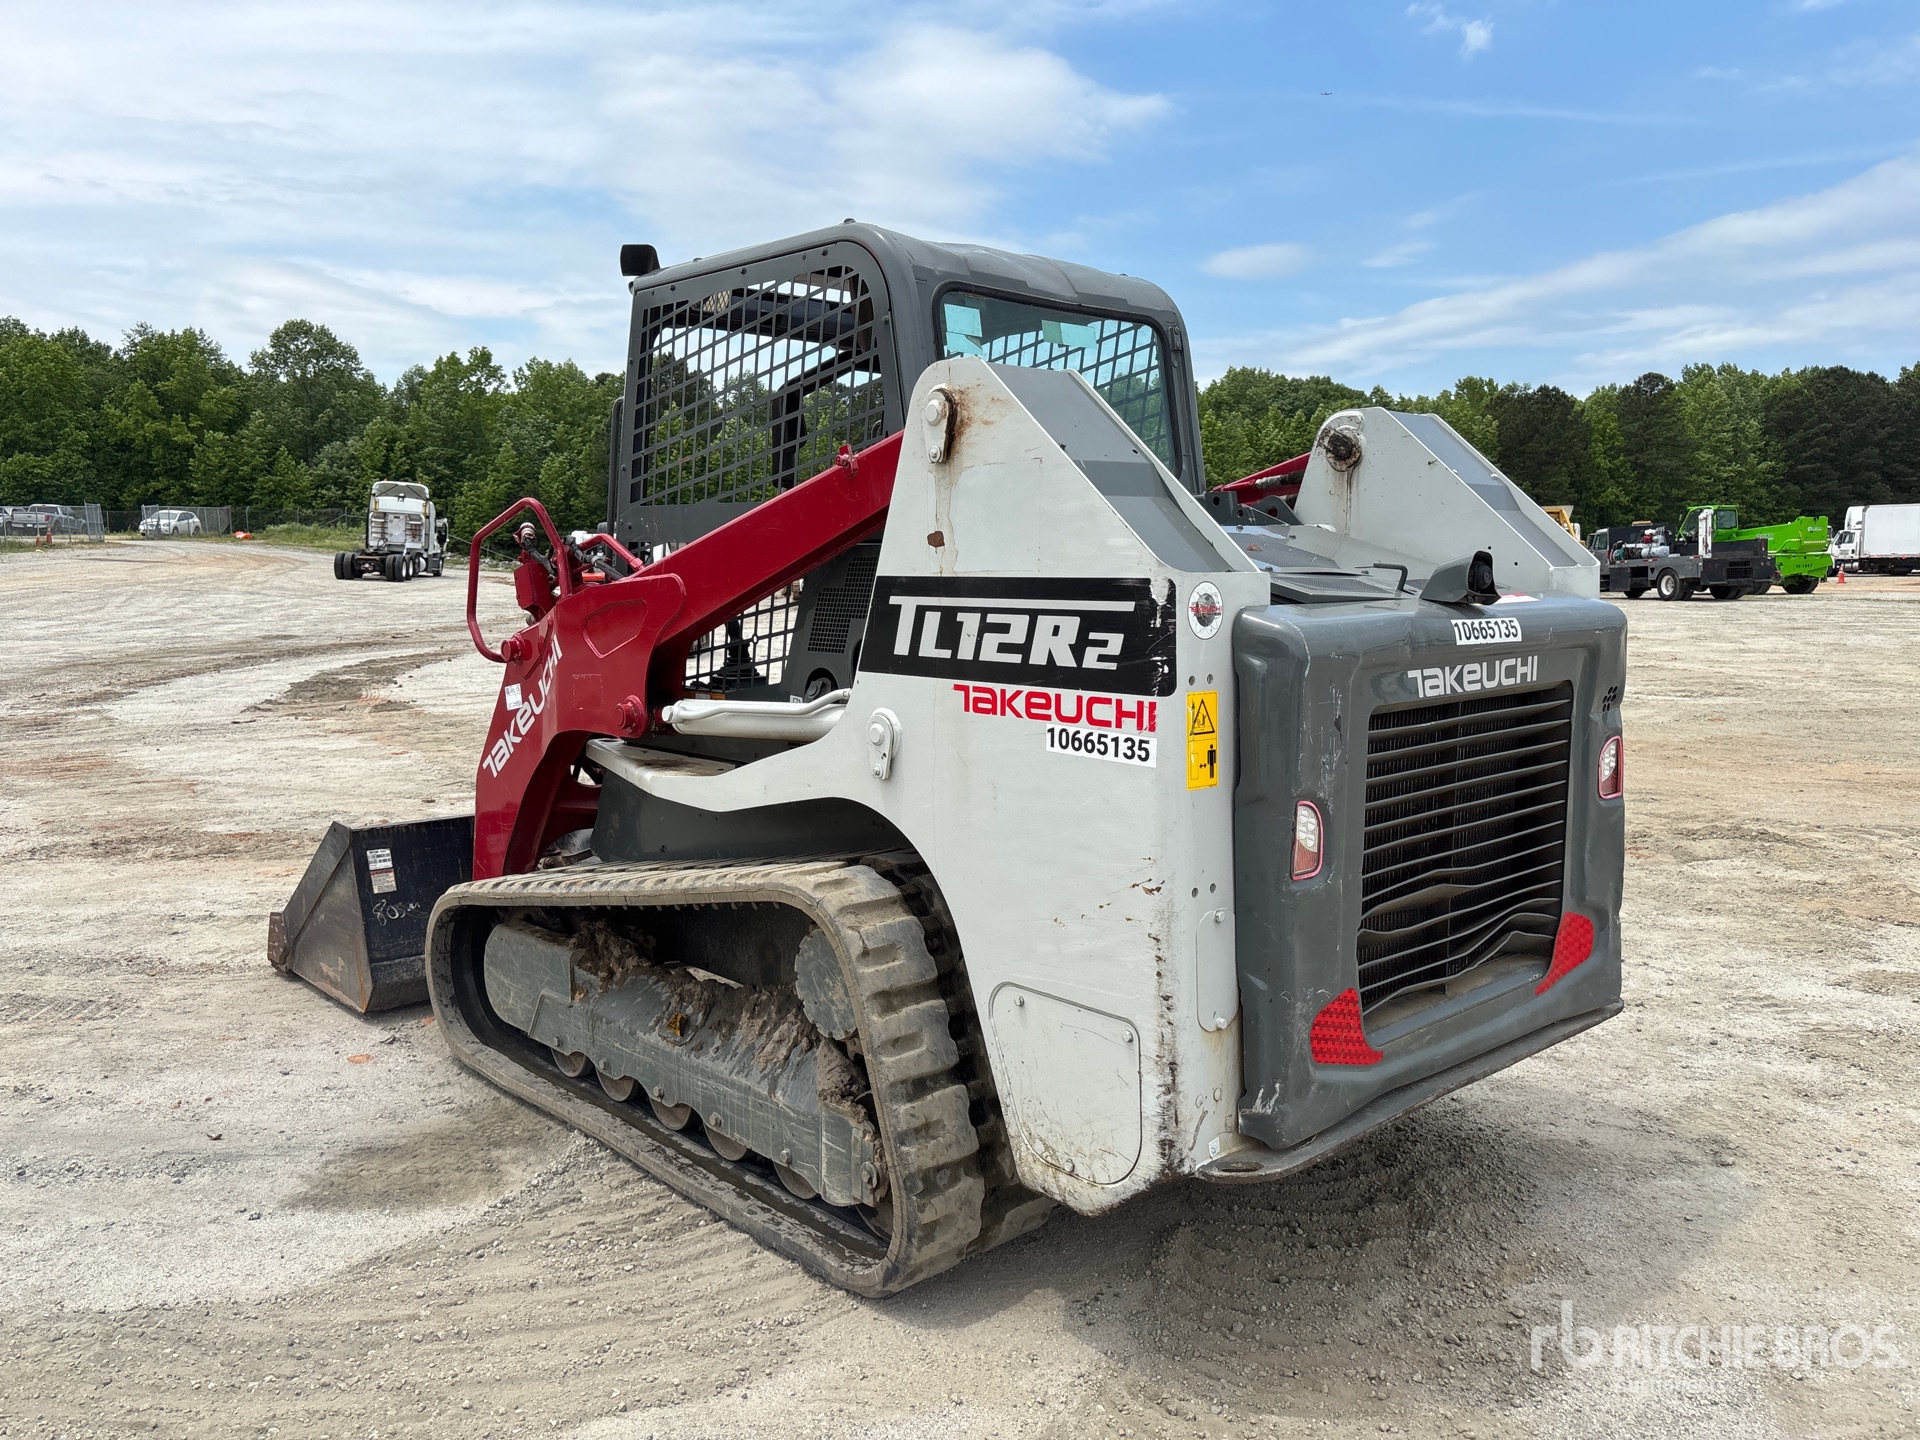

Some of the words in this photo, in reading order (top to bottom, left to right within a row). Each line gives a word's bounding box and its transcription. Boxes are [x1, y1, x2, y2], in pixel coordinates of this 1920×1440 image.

[889, 596, 1135, 670] TL12R2
[1454, 619, 1519, 641] 10665135
[1047, 726, 1150, 762] 10665135
